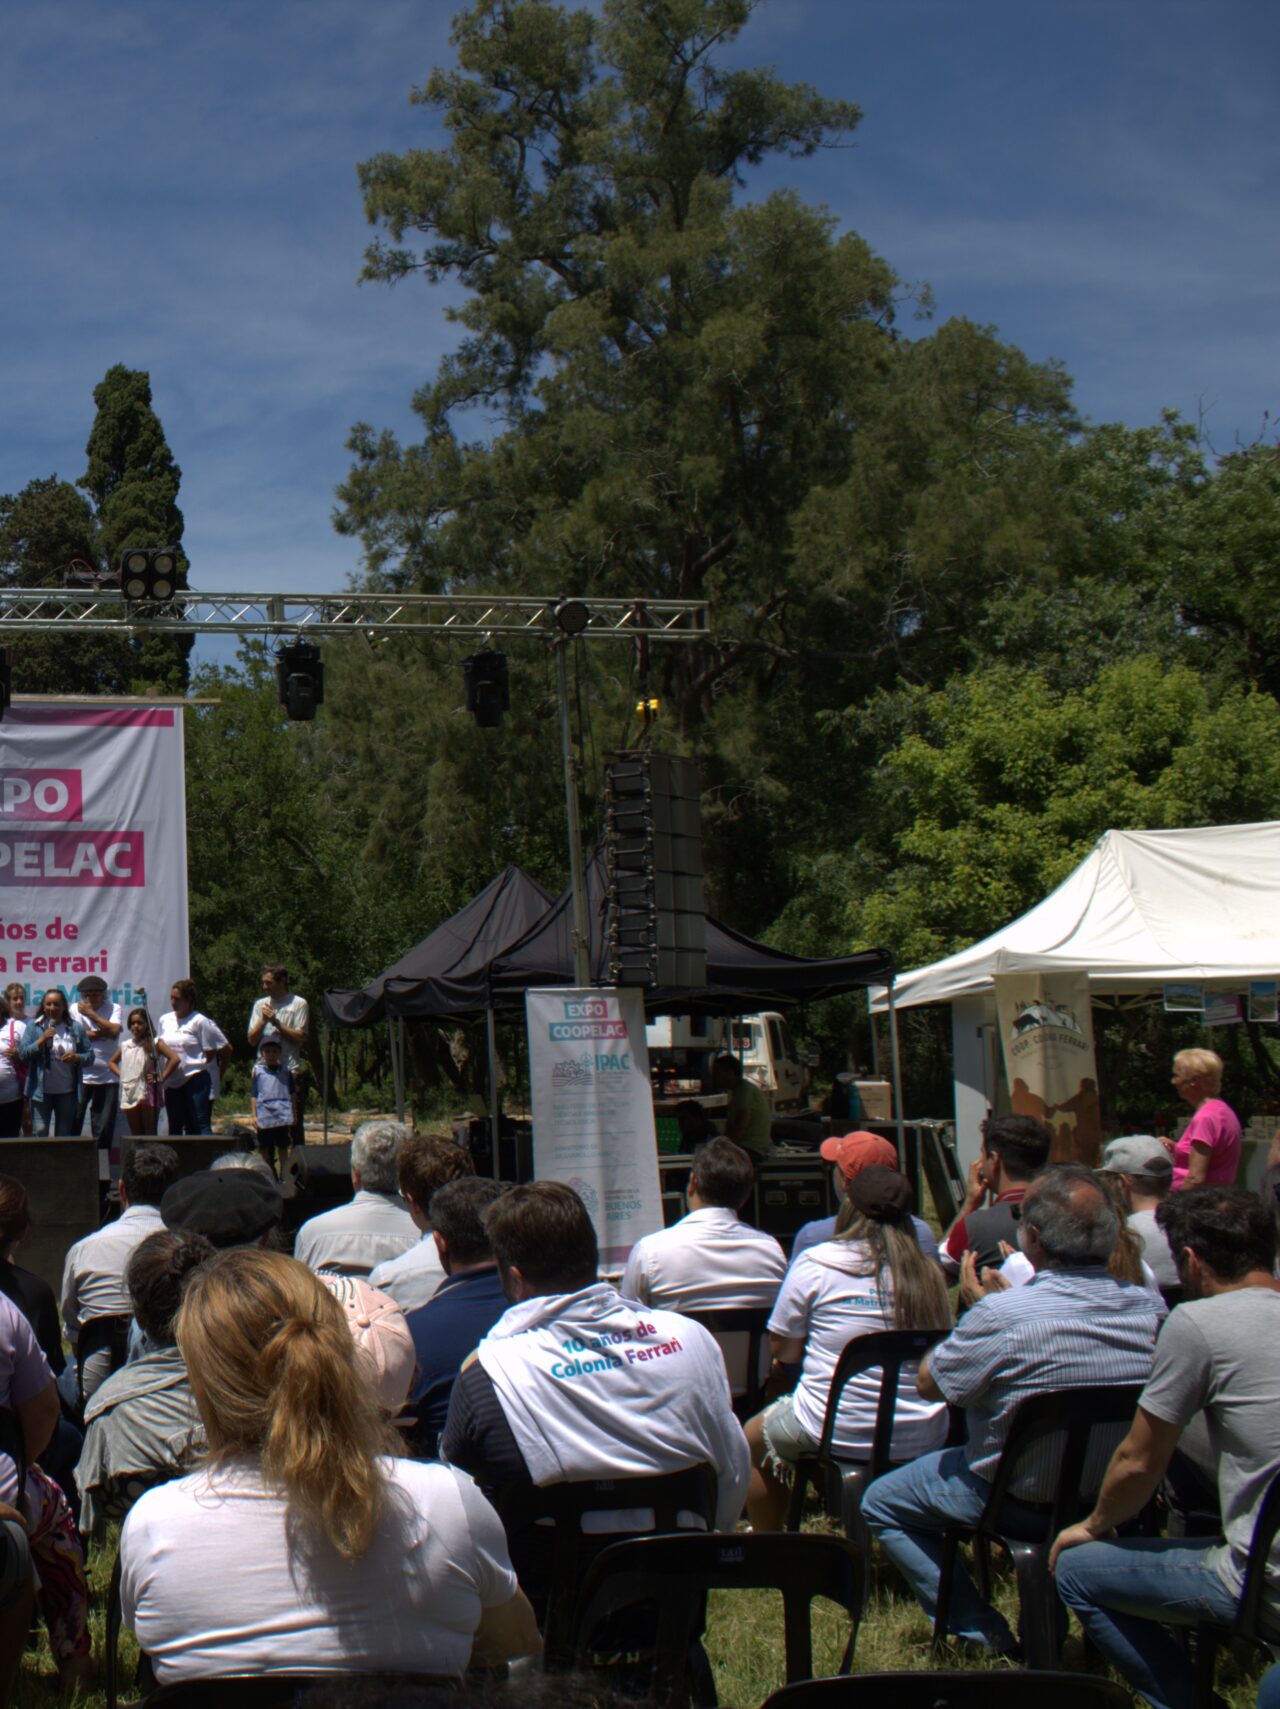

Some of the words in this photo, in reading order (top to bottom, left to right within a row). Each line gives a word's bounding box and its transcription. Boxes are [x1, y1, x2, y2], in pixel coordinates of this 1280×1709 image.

[45, 916, 79, 940] de
[16, 949, 109, 973] Ferrari
[57, 983, 147, 1007] Mria
[567, 1004, 604, 1017] EXPO
[553, 1024, 624, 1039] COOPELAC
[595, 1054, 630, 1072] IPAC
[606, 1200, 642, 1212] BUENOS
[563, 1336, 586, 1354] 10
[590, 1328, 632, 1350] años
[636, 1320, 657, 1338] de
[551, 1352, 623, 1379] Colonia
[624, 1336, 683, 1364] Ferrari
